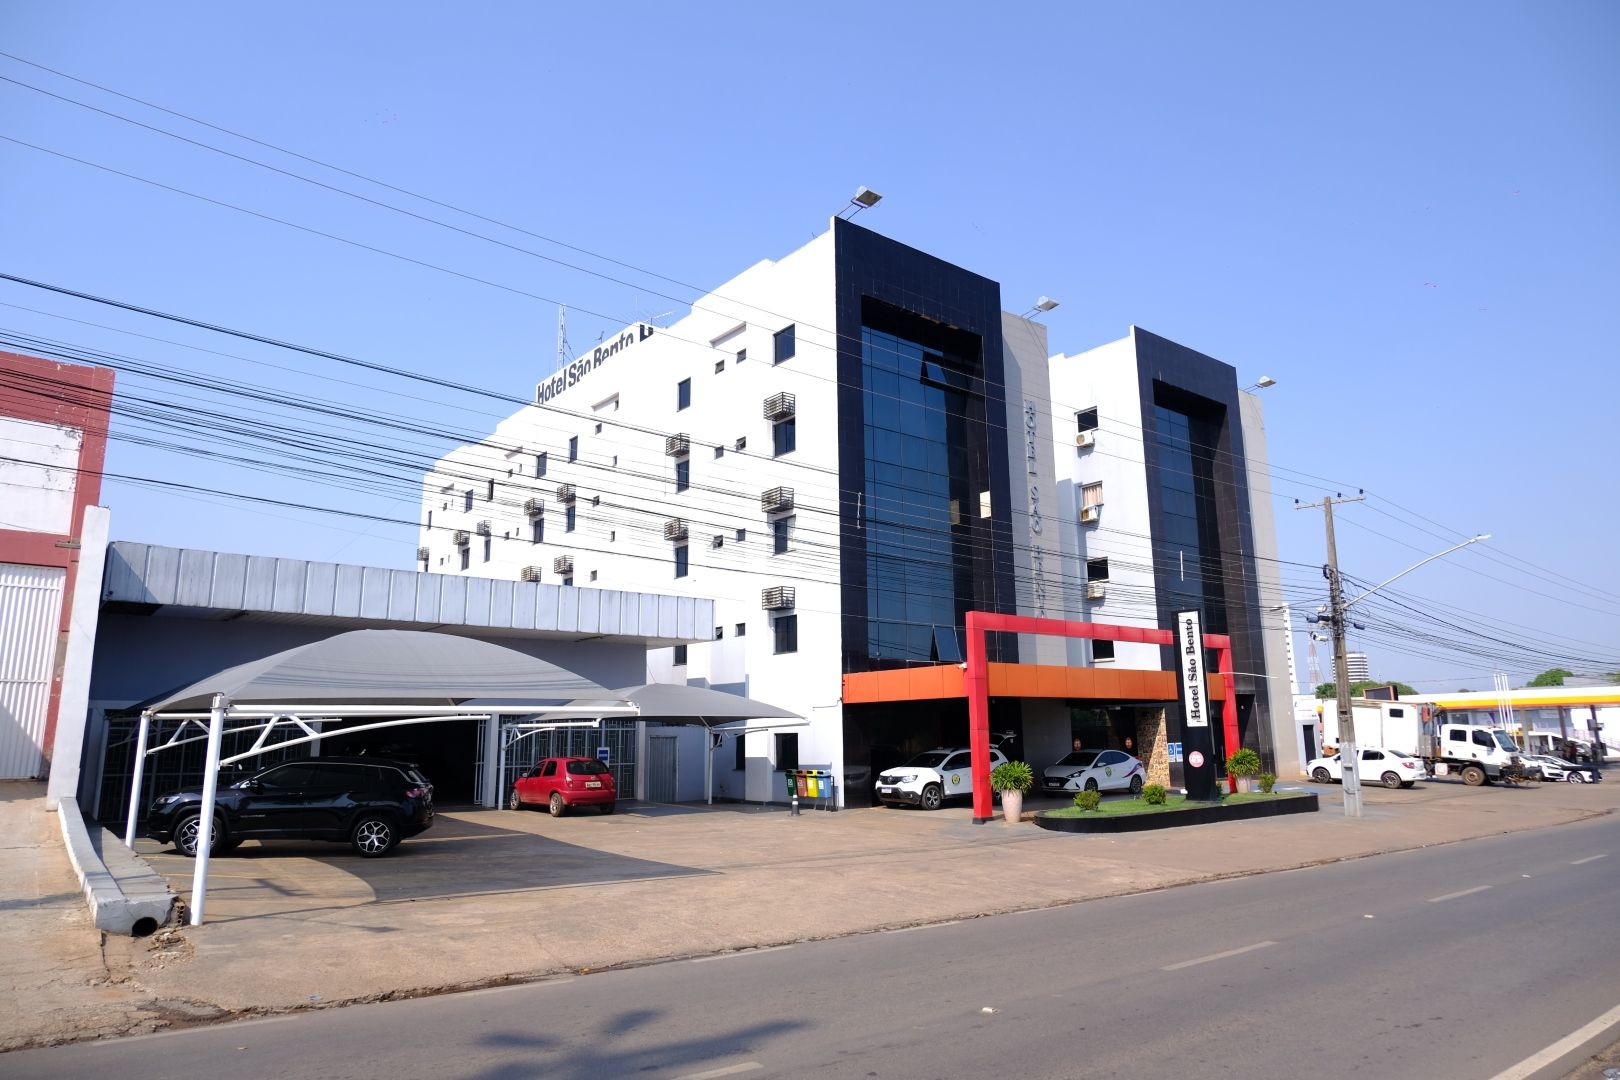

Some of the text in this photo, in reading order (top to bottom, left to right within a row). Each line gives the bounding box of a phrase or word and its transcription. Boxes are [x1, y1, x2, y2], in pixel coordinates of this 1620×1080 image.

[537, 368, 567, 404] Hotel
[1024, 400, 1037, 475] HOTEL
[1185, 618, 1201, 720] Hotel São Bento
